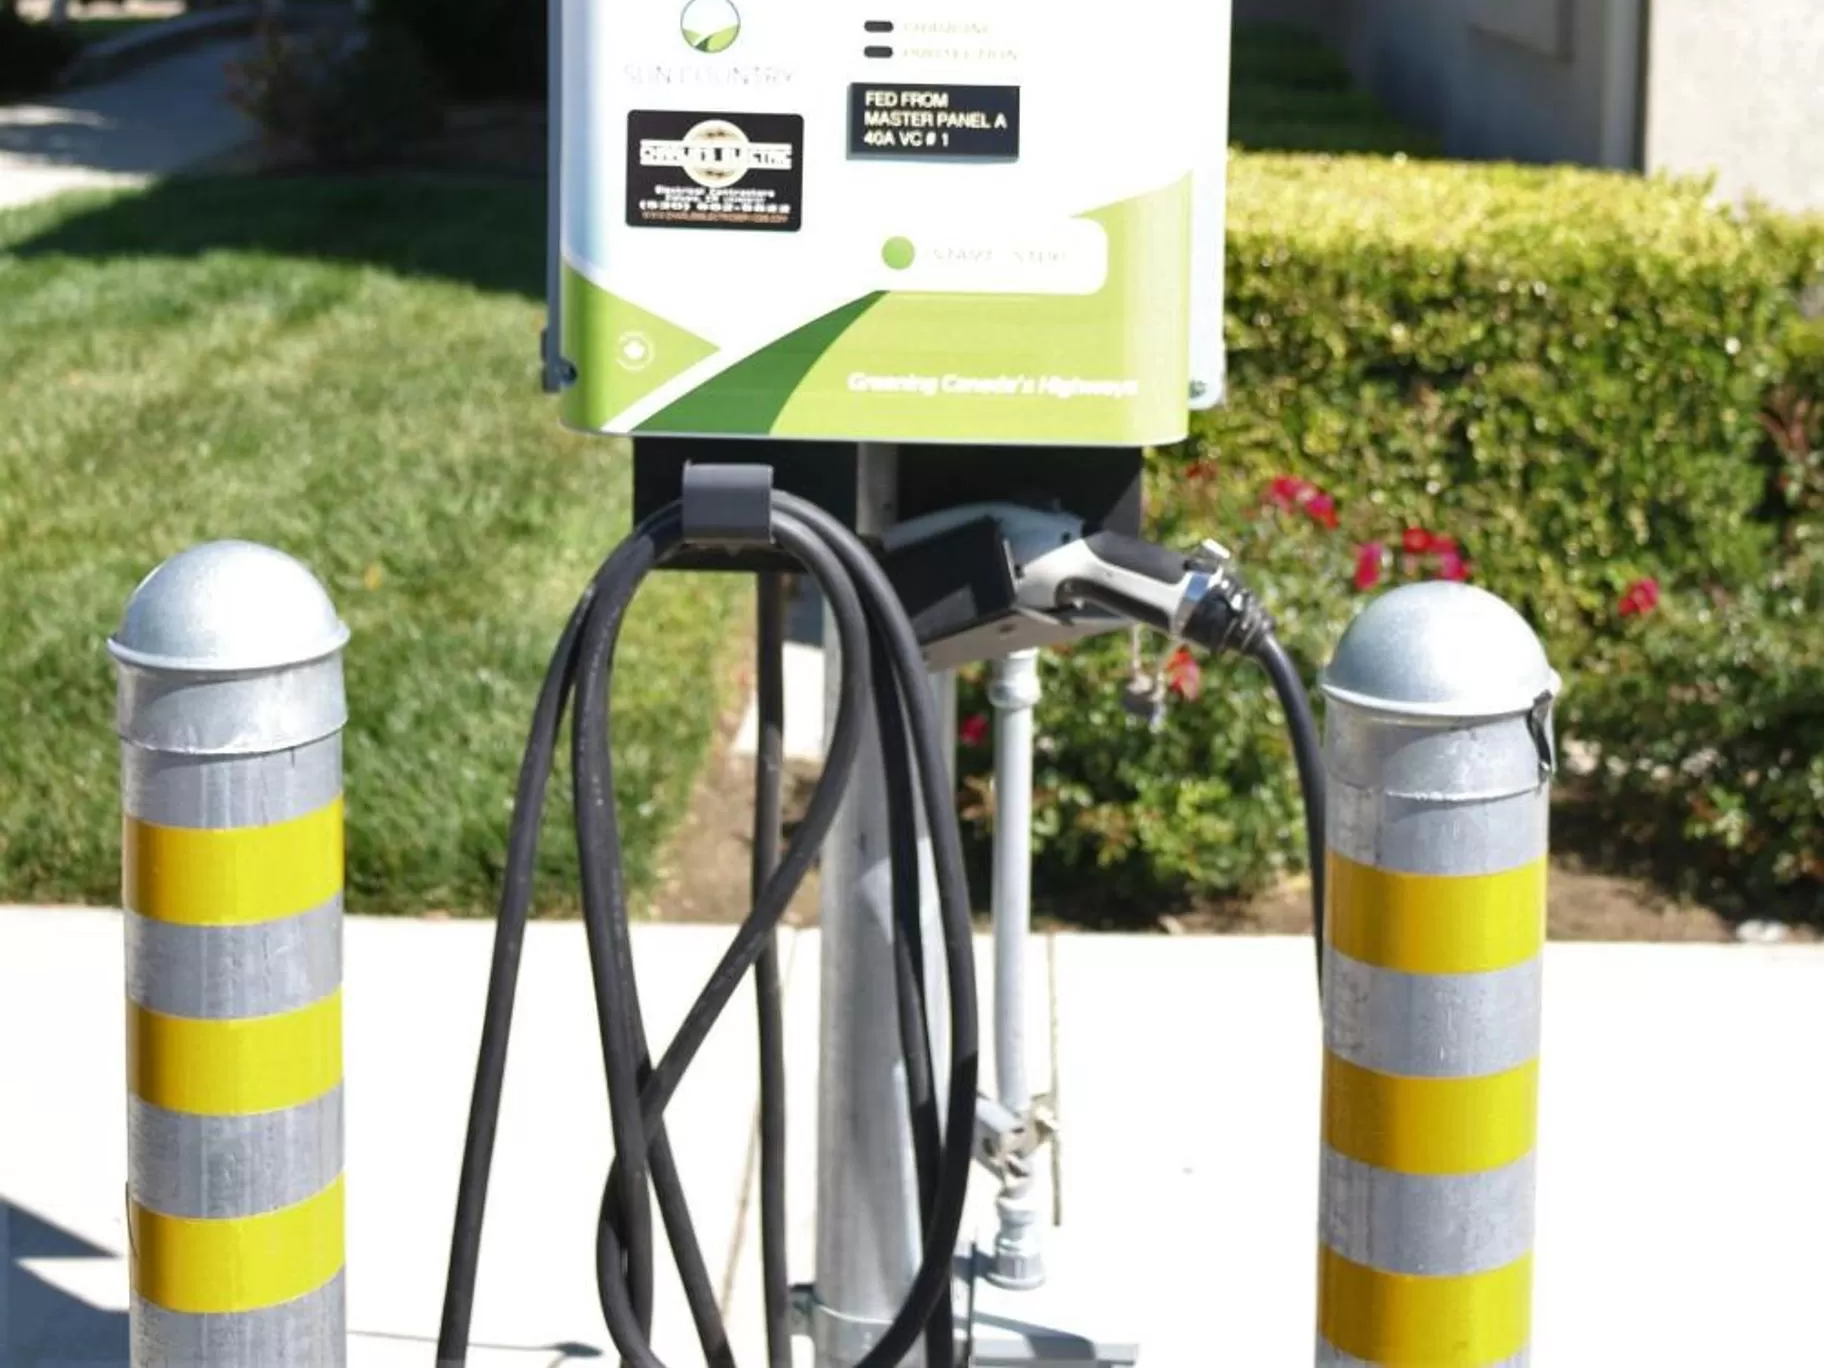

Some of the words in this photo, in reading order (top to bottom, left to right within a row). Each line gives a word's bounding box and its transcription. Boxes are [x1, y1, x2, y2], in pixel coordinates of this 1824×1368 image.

[864, 90, 898, 107] FED
[900, 91, 949, 108] FROM
[864, 110, 934, 127] MASTER
[936, 111, 991, 129] PANEL
[993, 112, 1008, 129] A
[863, 130, 896, 146] 40A
[847, 372, 938, 397] Greening
[1037, 375, 1140, 398] Highways
